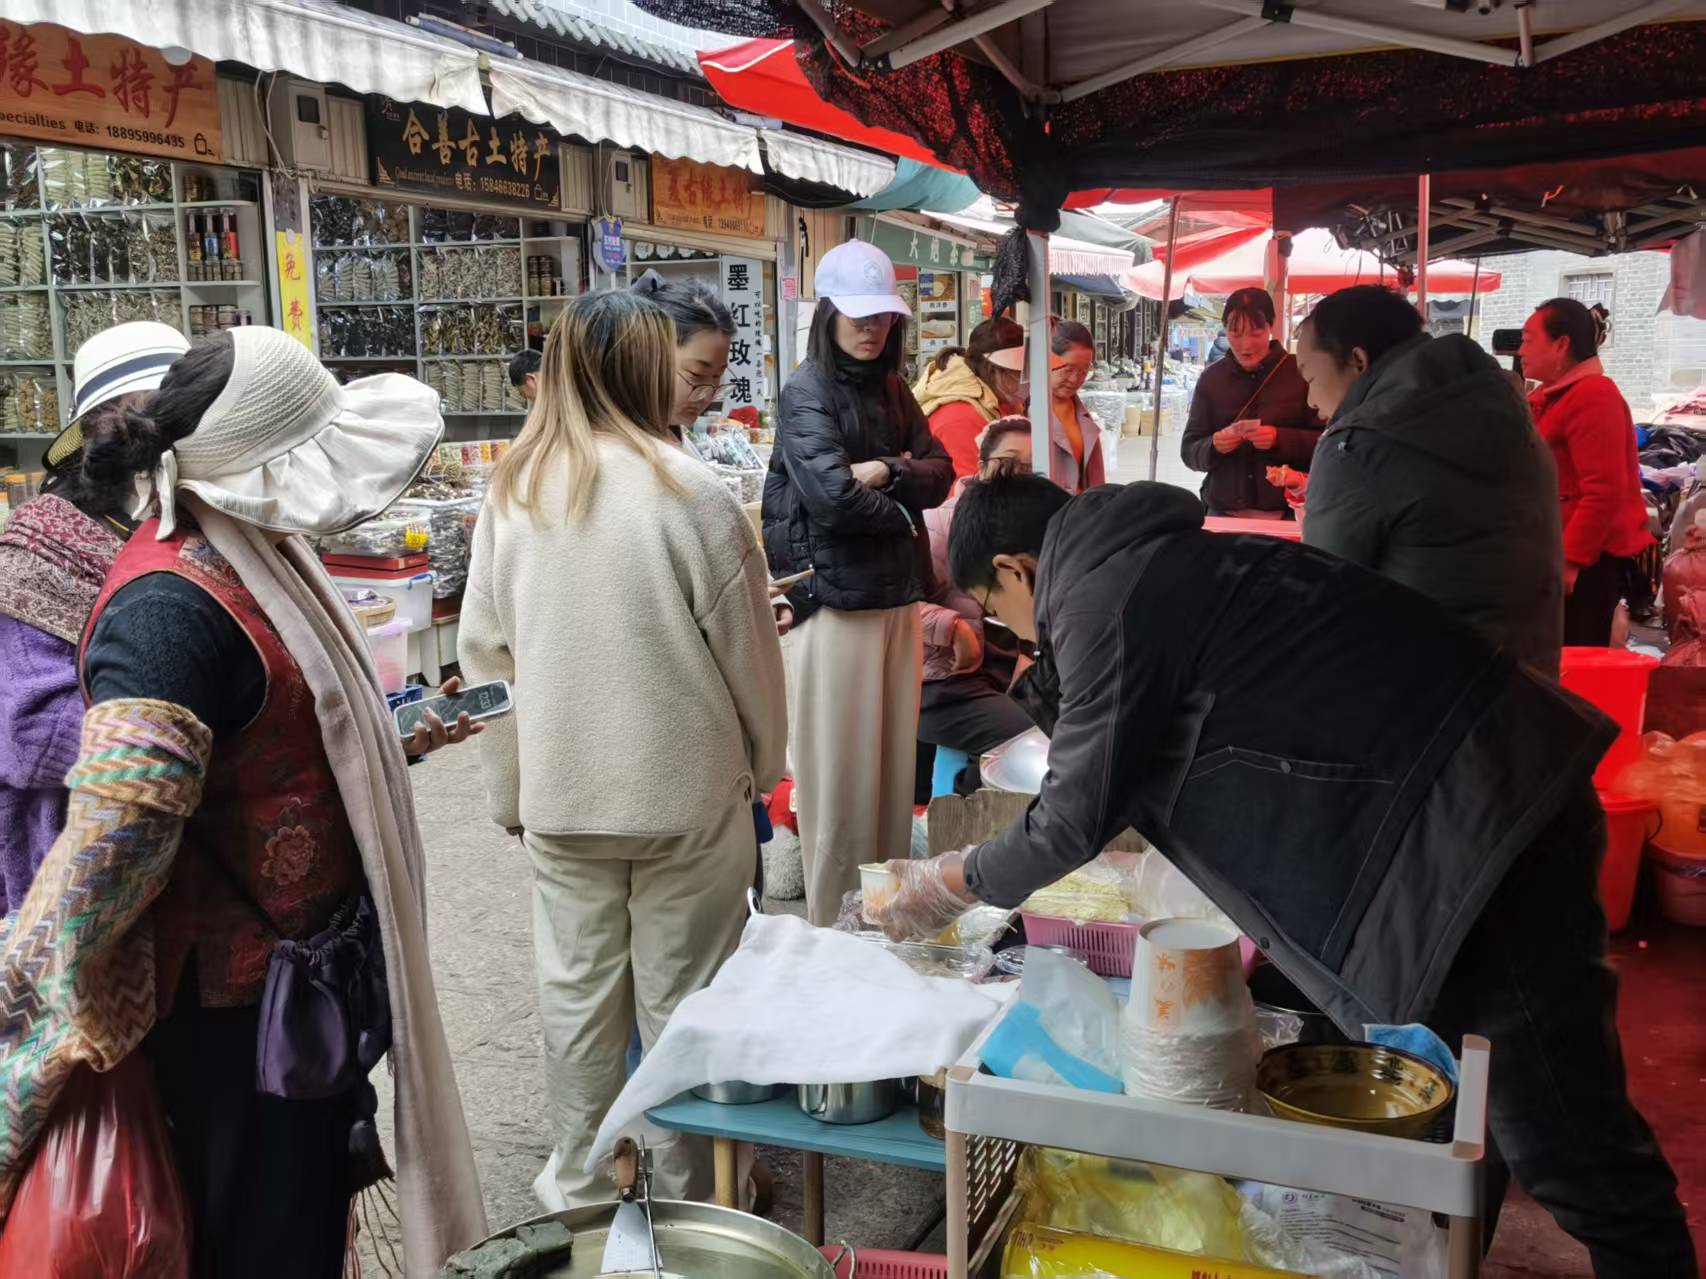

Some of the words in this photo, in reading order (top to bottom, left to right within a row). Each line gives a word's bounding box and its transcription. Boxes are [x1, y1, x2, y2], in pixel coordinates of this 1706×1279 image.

[106, 125, 185, 149] 18895996435
[728, 264, 752, 403] 墨红玫瑰
